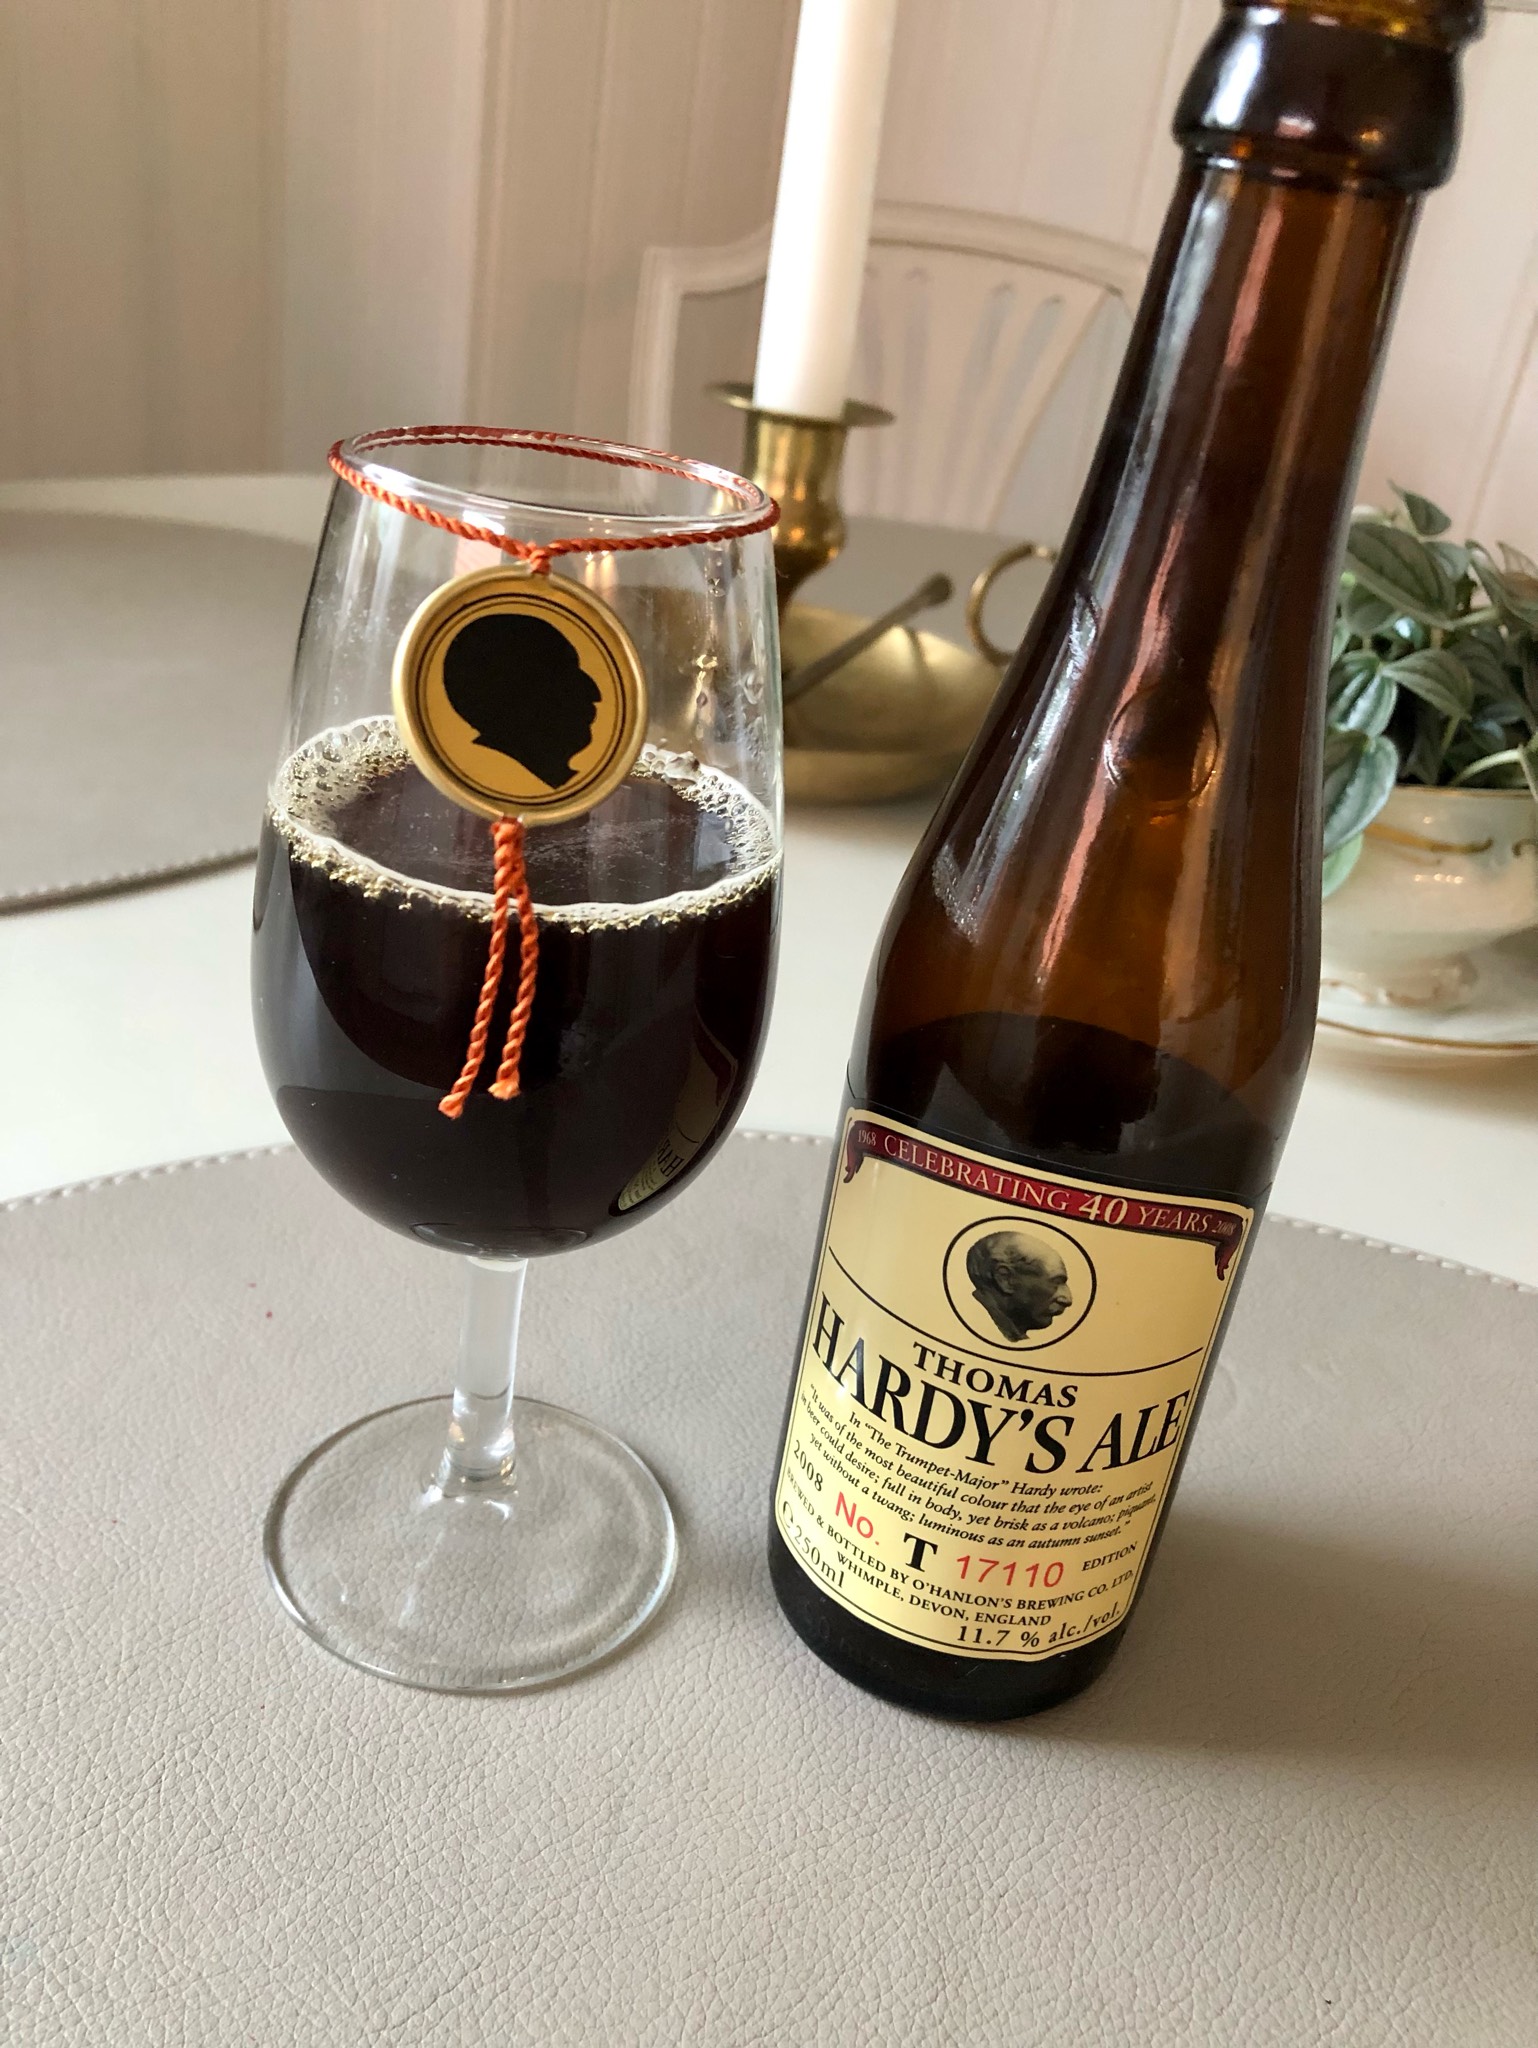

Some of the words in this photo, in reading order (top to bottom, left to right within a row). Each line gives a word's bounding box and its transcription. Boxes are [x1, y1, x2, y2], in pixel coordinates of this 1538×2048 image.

[857, 1128, 876, 1147] 1968
[884, 1134, 1070, 1210] CELEBRATING
[1079, 1193, 1128, 1225] 40
[1138, 1205, 1213, 1233] YEARS
[1212, 1220, 1236, 1236] 2008
[812, 1291, 1075, 1474] HARDY'S
[1075, 1389, 1190, 1473] ALE
[912, 1341, 1078, 1408] THOMAS
[806, 1401, 820, 1426] beer
[820, 1426, 846, 1454] could
[845, 1451, 880, 1484] desire;
[881, 1477, 906, 1497] full
[907, 1490, 922, 1504] in
[924, 1497, 962, 1521] body,
[966, 1513, 991, 1525] yet
[993, 1516, 1029, 1531] brisk
[1031, 1521, 1047, 1531] as
[1049, 1521, 1059, 1530] a
[1062, 1514, 1115, 1530] volcano;
[810, 1433, 822, 1451] yet
[823, 1449, 860, 1488] without
[861, 1486, 870, 1495] a
[871, 1491, 915, 1522] twang;
[918, 1513, 986, 1543] luminous
[987, 1536, 1003, 1547] as
[1006, 1538, 1025, 1548] an
[1027, 1536, 1081, 1549] autumn
[818, 1401, 834, 1423] was
[834, 1421, 847, 1436] of
[846, 1431, 863, 1450] the
[864, 1447, 894, 1471] most
[896, 1464, 959, 1499] beautiful
[960, 1494, 1008, 1511] colour
[1010, 1500, 1043, 1514] that
[1043, 1502, 1067, 1514] the
[1068, 1503, 1091, 1515] eye
[1093, 1494, 1111, 1511] of
[1108, 1494, 1124, 1506] an
[1125, 1481, 1153, 1500] artist
[849, 1411, 861, 1428] In
[1010, 1482, 1057, 1499] Hardy
[1059, 1484, 1103, 1496] wrote:
[793, 1439, 823, 1491] 2008
[835, 1491, 880, 1545] No.
[903, 1532, 938, 1573] T
[956, 1555, 1064, 1588] 17110
[1081, 1540, 1138, 1571] EDITION
[816, 1515, 824, 1528] &
[827, 1524, 886, 1573] BOTTLED
[890, 1568, 910, 1585] BY
[912, 1579, 1013, 1609] O'HANLON'S
[1016, 1590, 1085, 1610] BREWING
[1087, 1583, 1108, 1598] CO.
[837, 1550, 904, 1602] WHIMPLE,
[908, 1594, 968, 1621] DEVON,
[974, 1612, 1051, 1626] ENGLAND
[957, 1625, 1010, 1646] 11.7
[1020, 1631, 1040, 1647] %
[1048, 1601, 1120, 1644] alc./vol.
